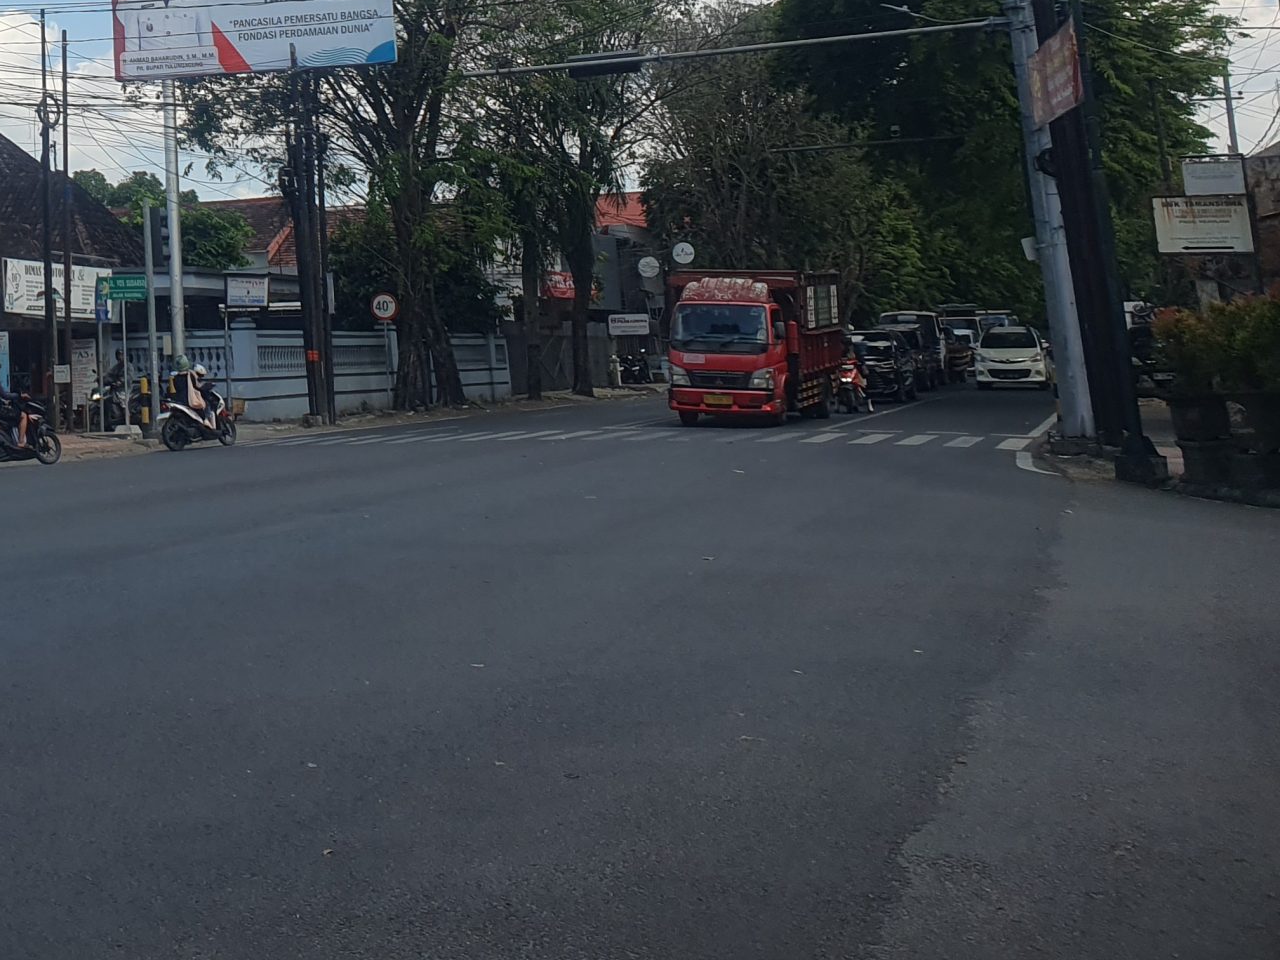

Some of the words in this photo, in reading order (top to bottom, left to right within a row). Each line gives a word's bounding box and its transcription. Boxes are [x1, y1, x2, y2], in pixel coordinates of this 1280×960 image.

[284, 12, 339, 25] PEMERSATU
[238, 30, 277, 42] FONDASI
[279, 26, 339, 39] PERDAMAIAN
[375, 300, 389, 312] 40
